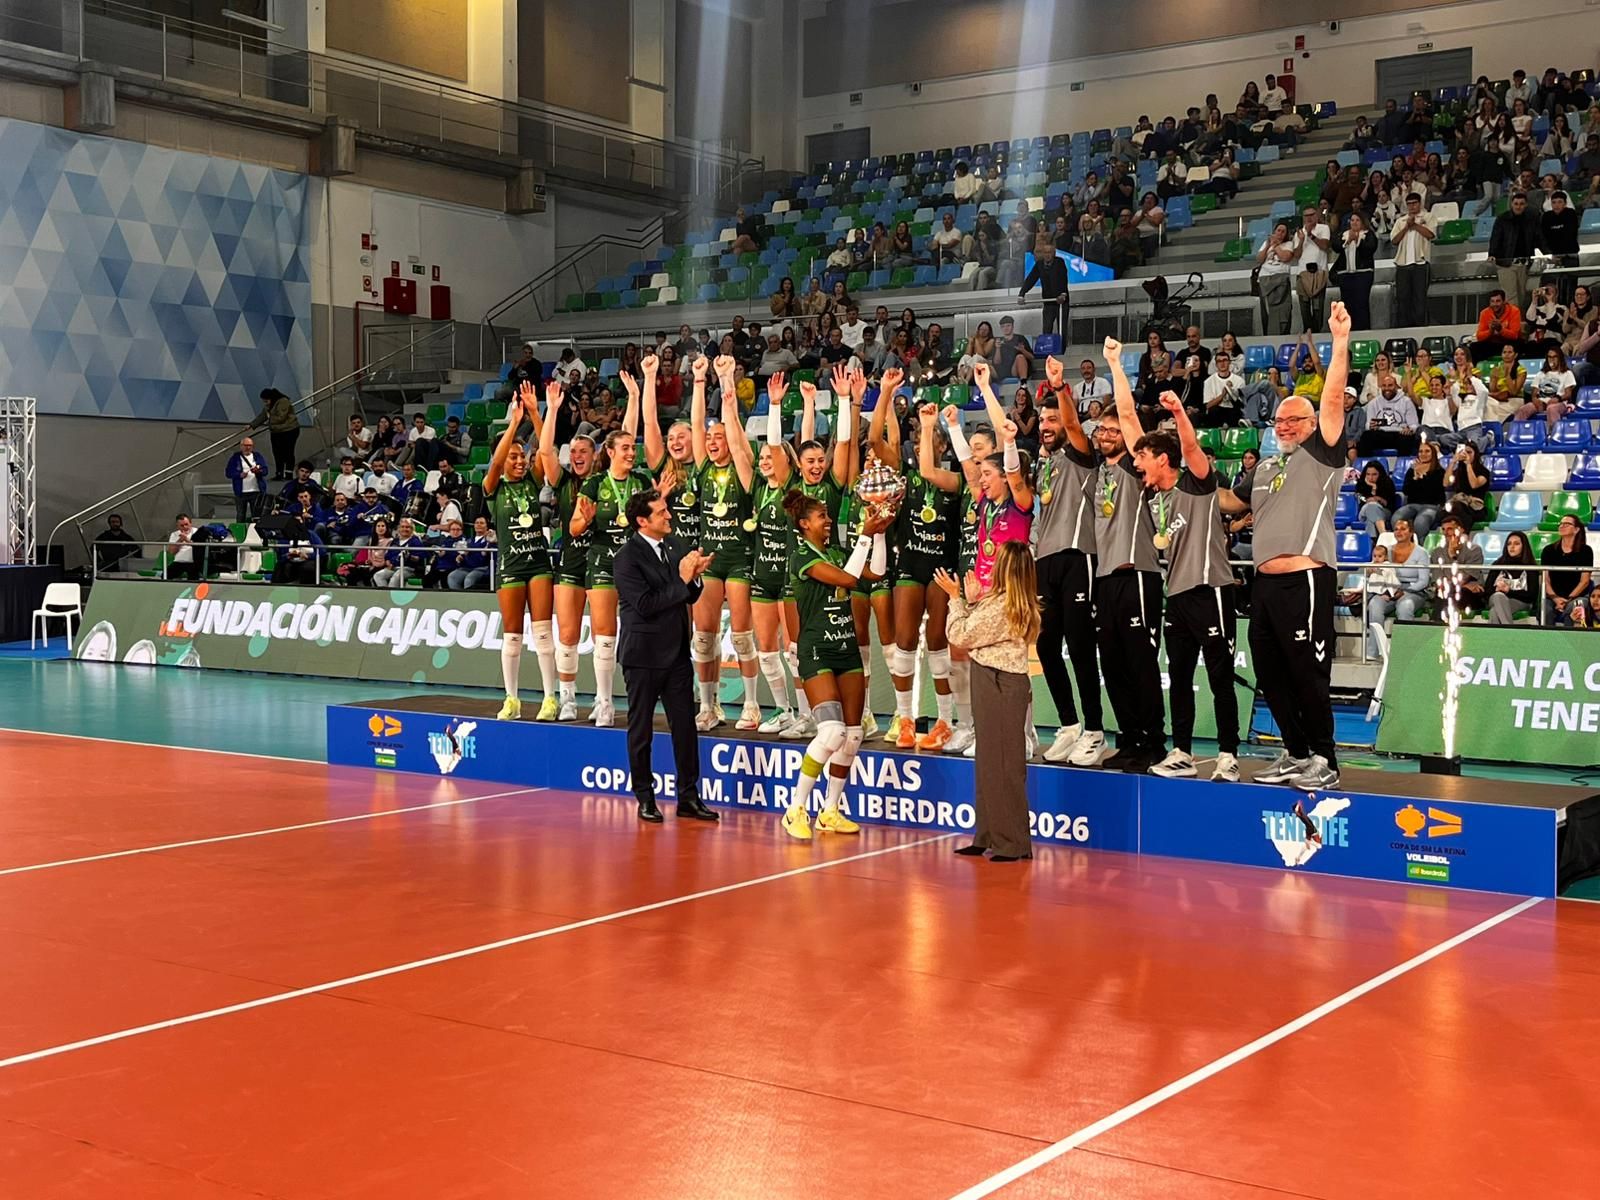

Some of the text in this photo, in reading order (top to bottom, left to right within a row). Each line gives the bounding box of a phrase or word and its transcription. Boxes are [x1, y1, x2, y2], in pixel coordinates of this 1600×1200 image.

[166, 594, 357, 642] FUNDACIÓN
[357, 606, 503, 656] CAJASOL
[1457, 656, 1574, 690] SANTA
[1511, 699, 1600, 733] TENE
[711, 743, 922, 792] CAMPNAS
[737, 781, 768, 807] LA
[858, 792, 976, 829] IBERDRO
